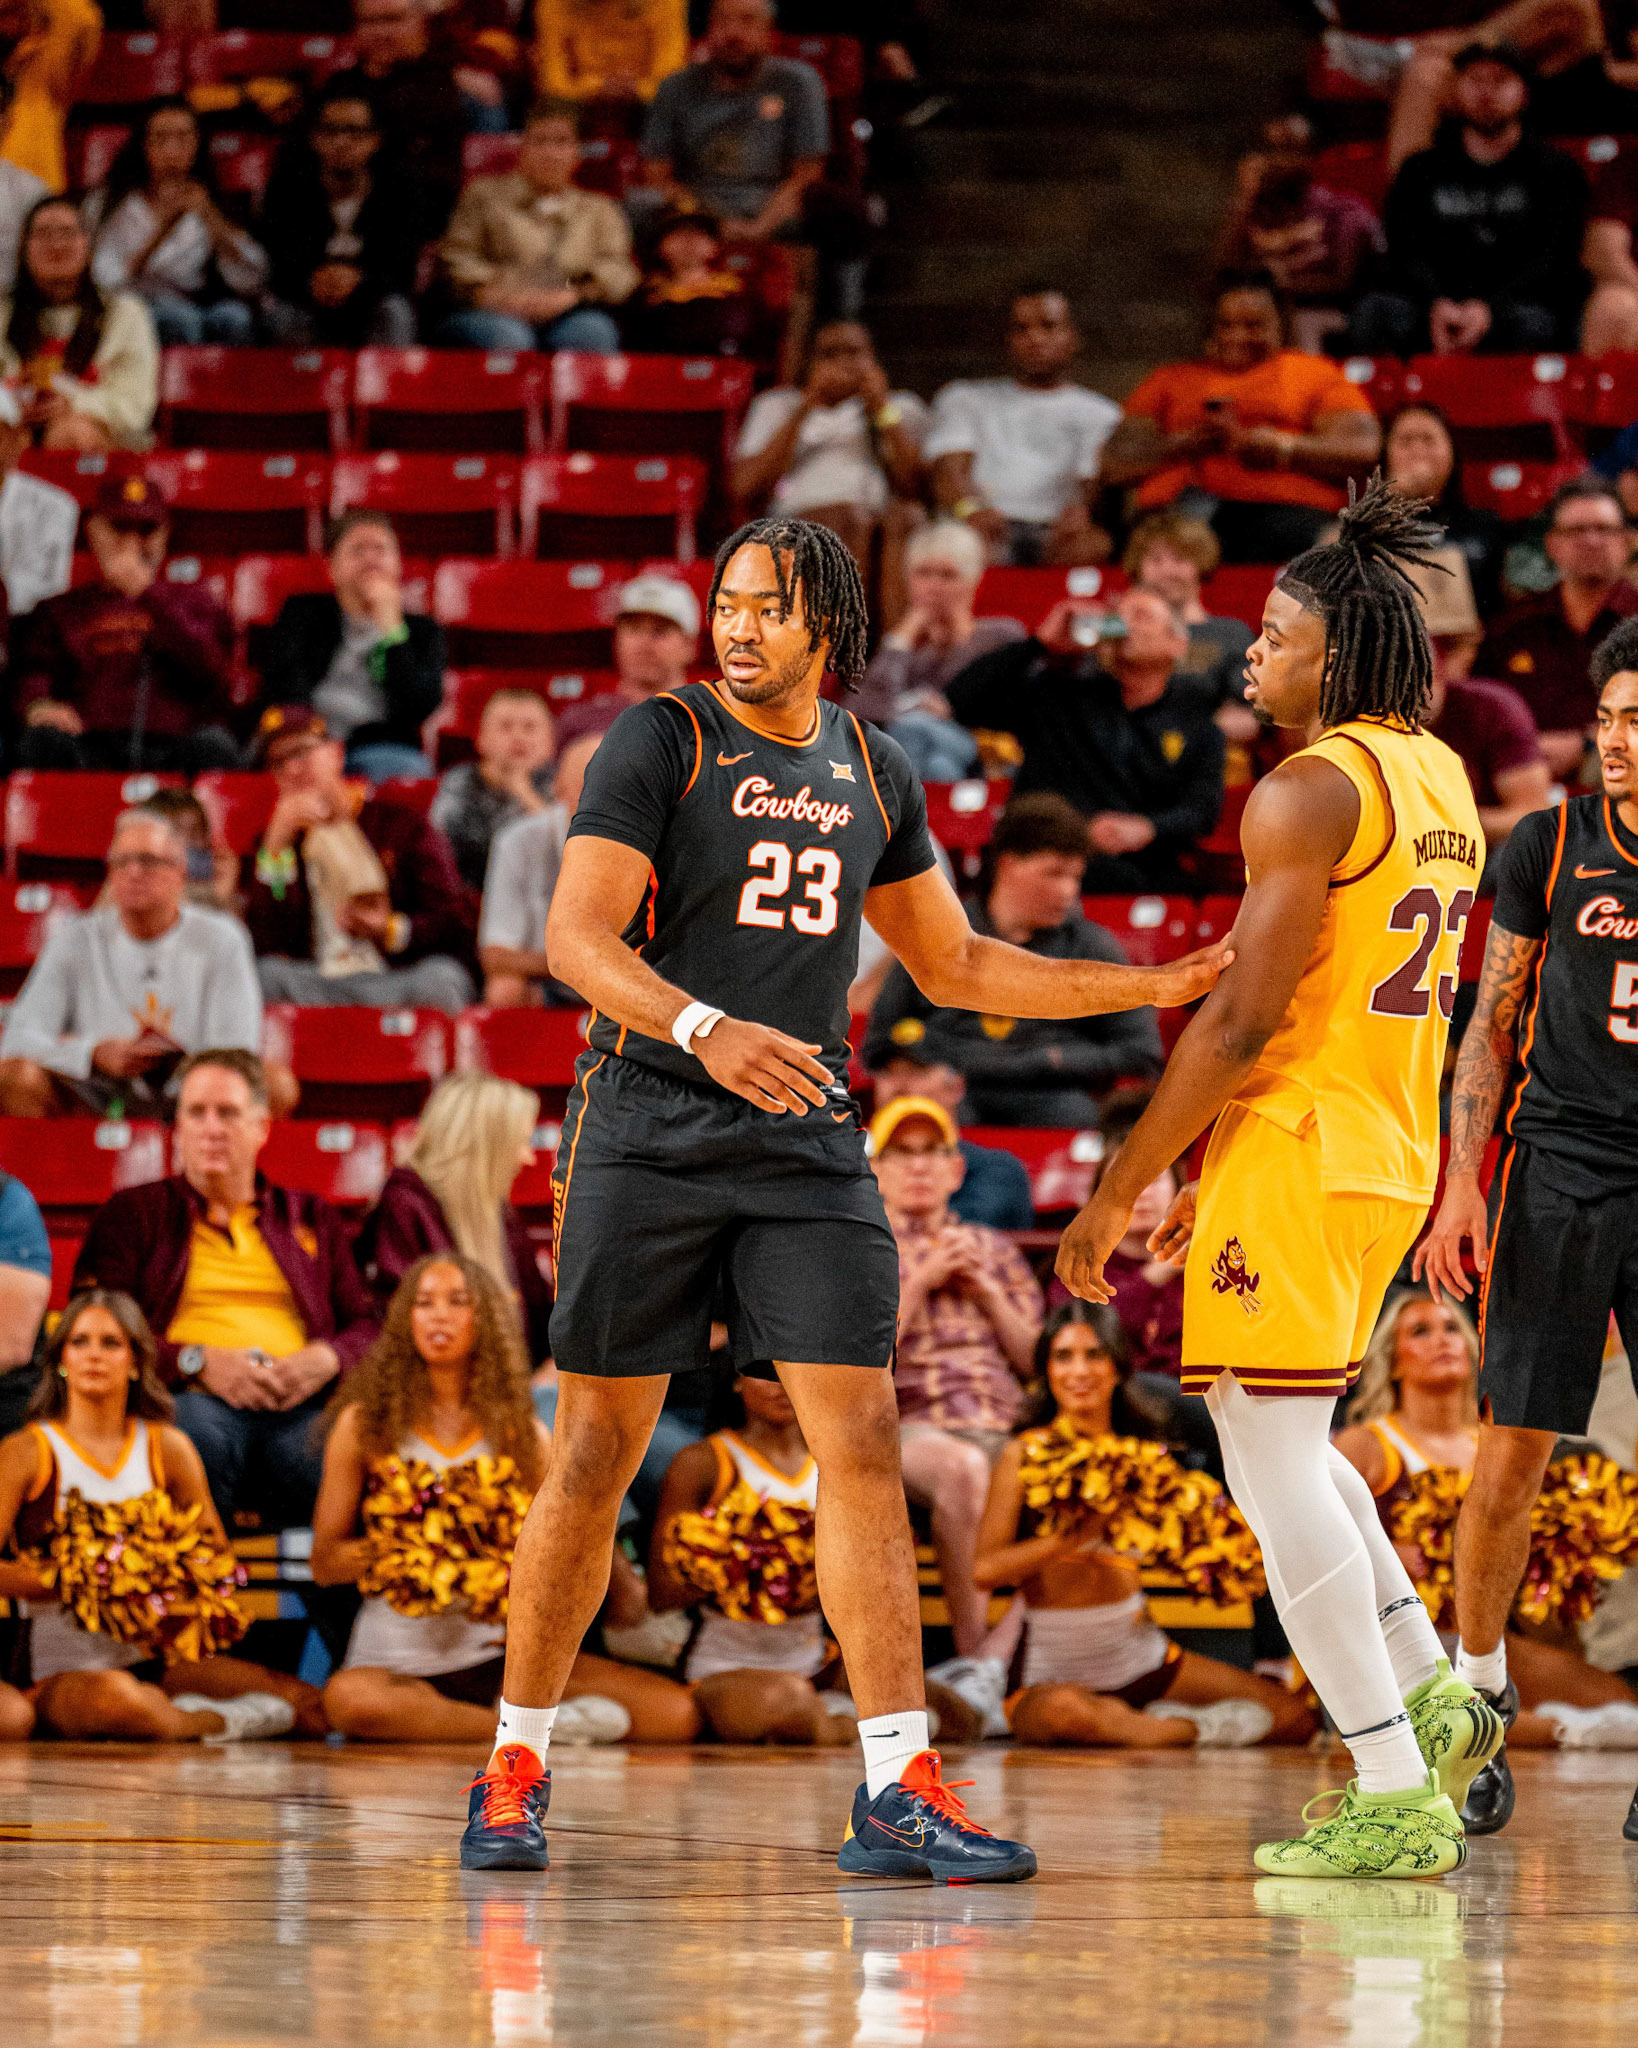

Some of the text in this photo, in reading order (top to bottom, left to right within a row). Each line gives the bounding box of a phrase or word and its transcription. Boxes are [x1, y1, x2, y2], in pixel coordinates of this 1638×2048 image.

[732, 775, 854, 834] Cowboys
[736, 840, 843, 937] 23
[1413, 830, 1476, 870] MUKEBA
[1368, 885, 1475, 1022] 23
[1607, 961, 1638, 1044] 5
